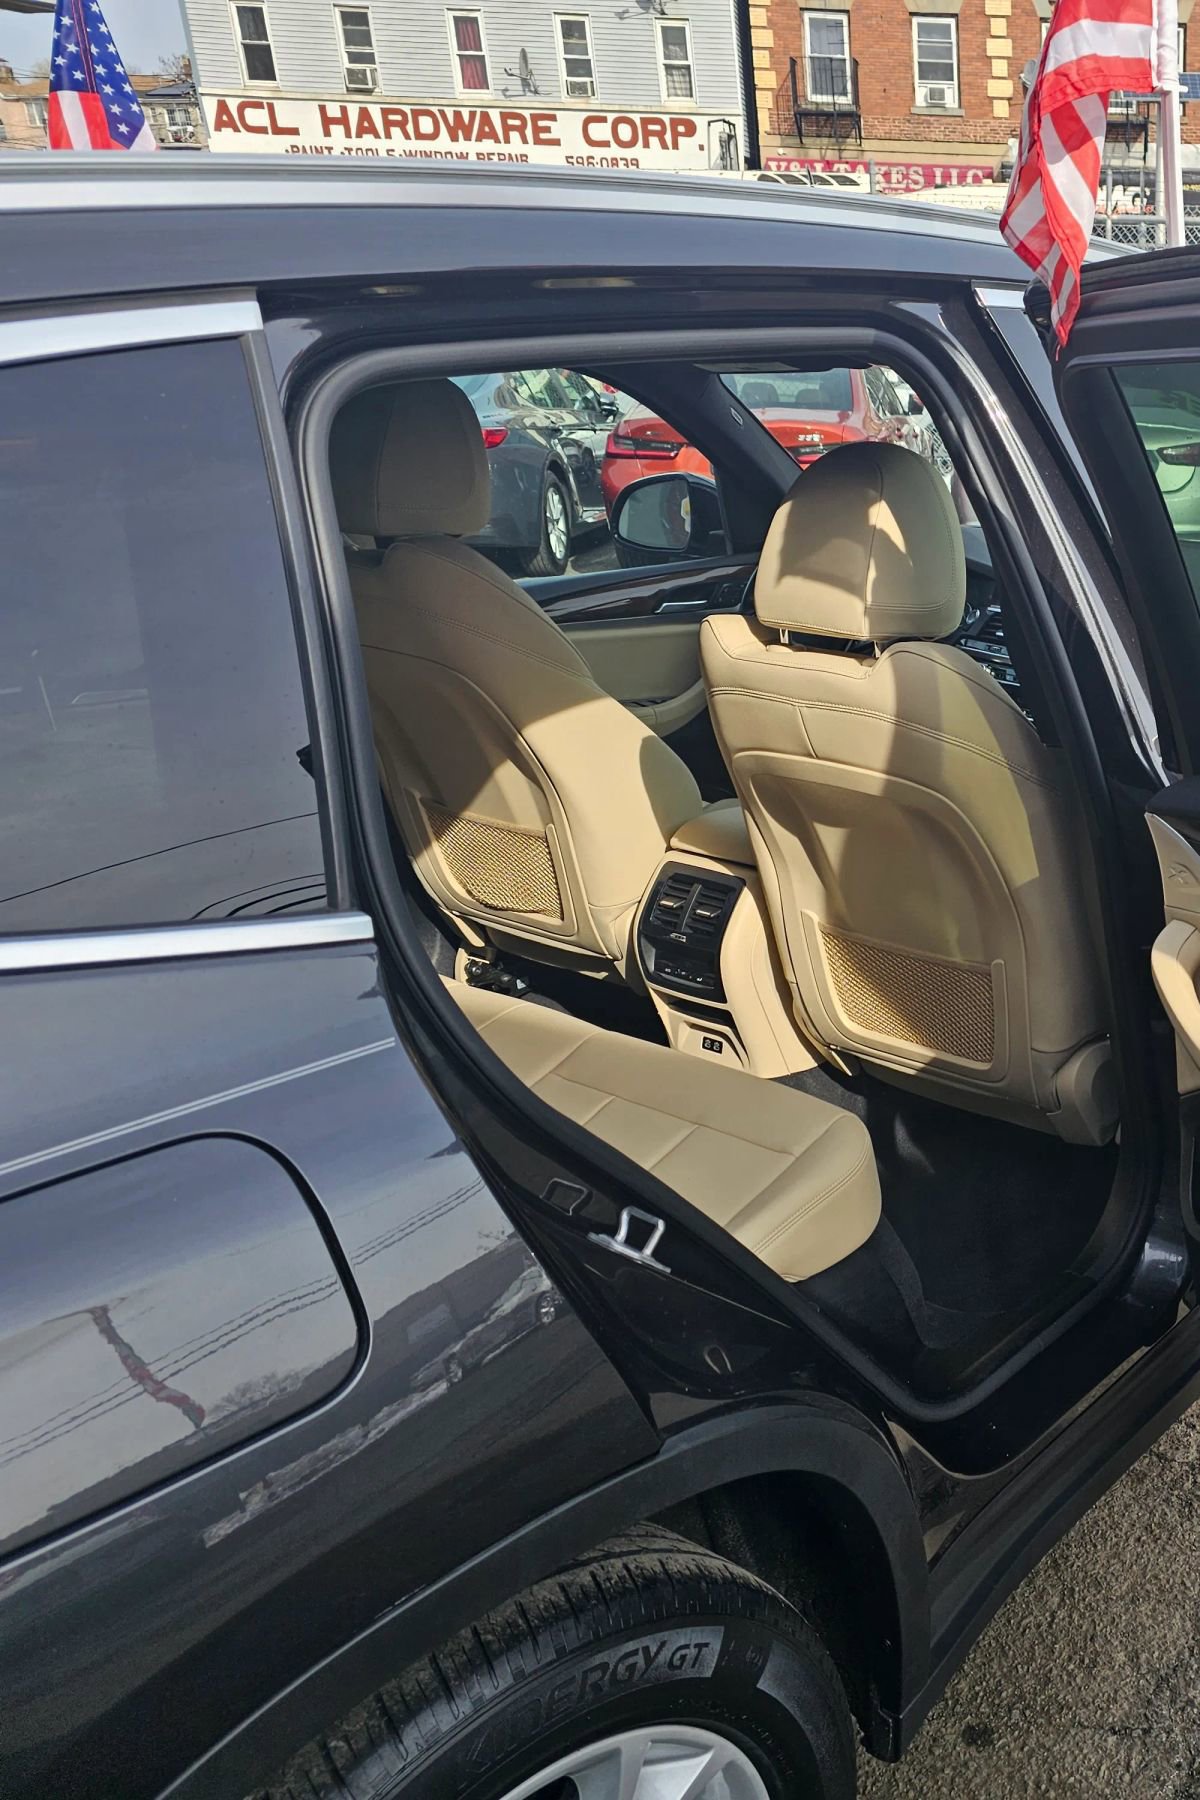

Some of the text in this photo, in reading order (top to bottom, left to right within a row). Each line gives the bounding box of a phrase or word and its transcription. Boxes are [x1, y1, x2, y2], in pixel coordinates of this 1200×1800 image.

[213, 98, 705, 152] ACL HARDWARE CORP.
[666, 1642, 710, 1673] GT
